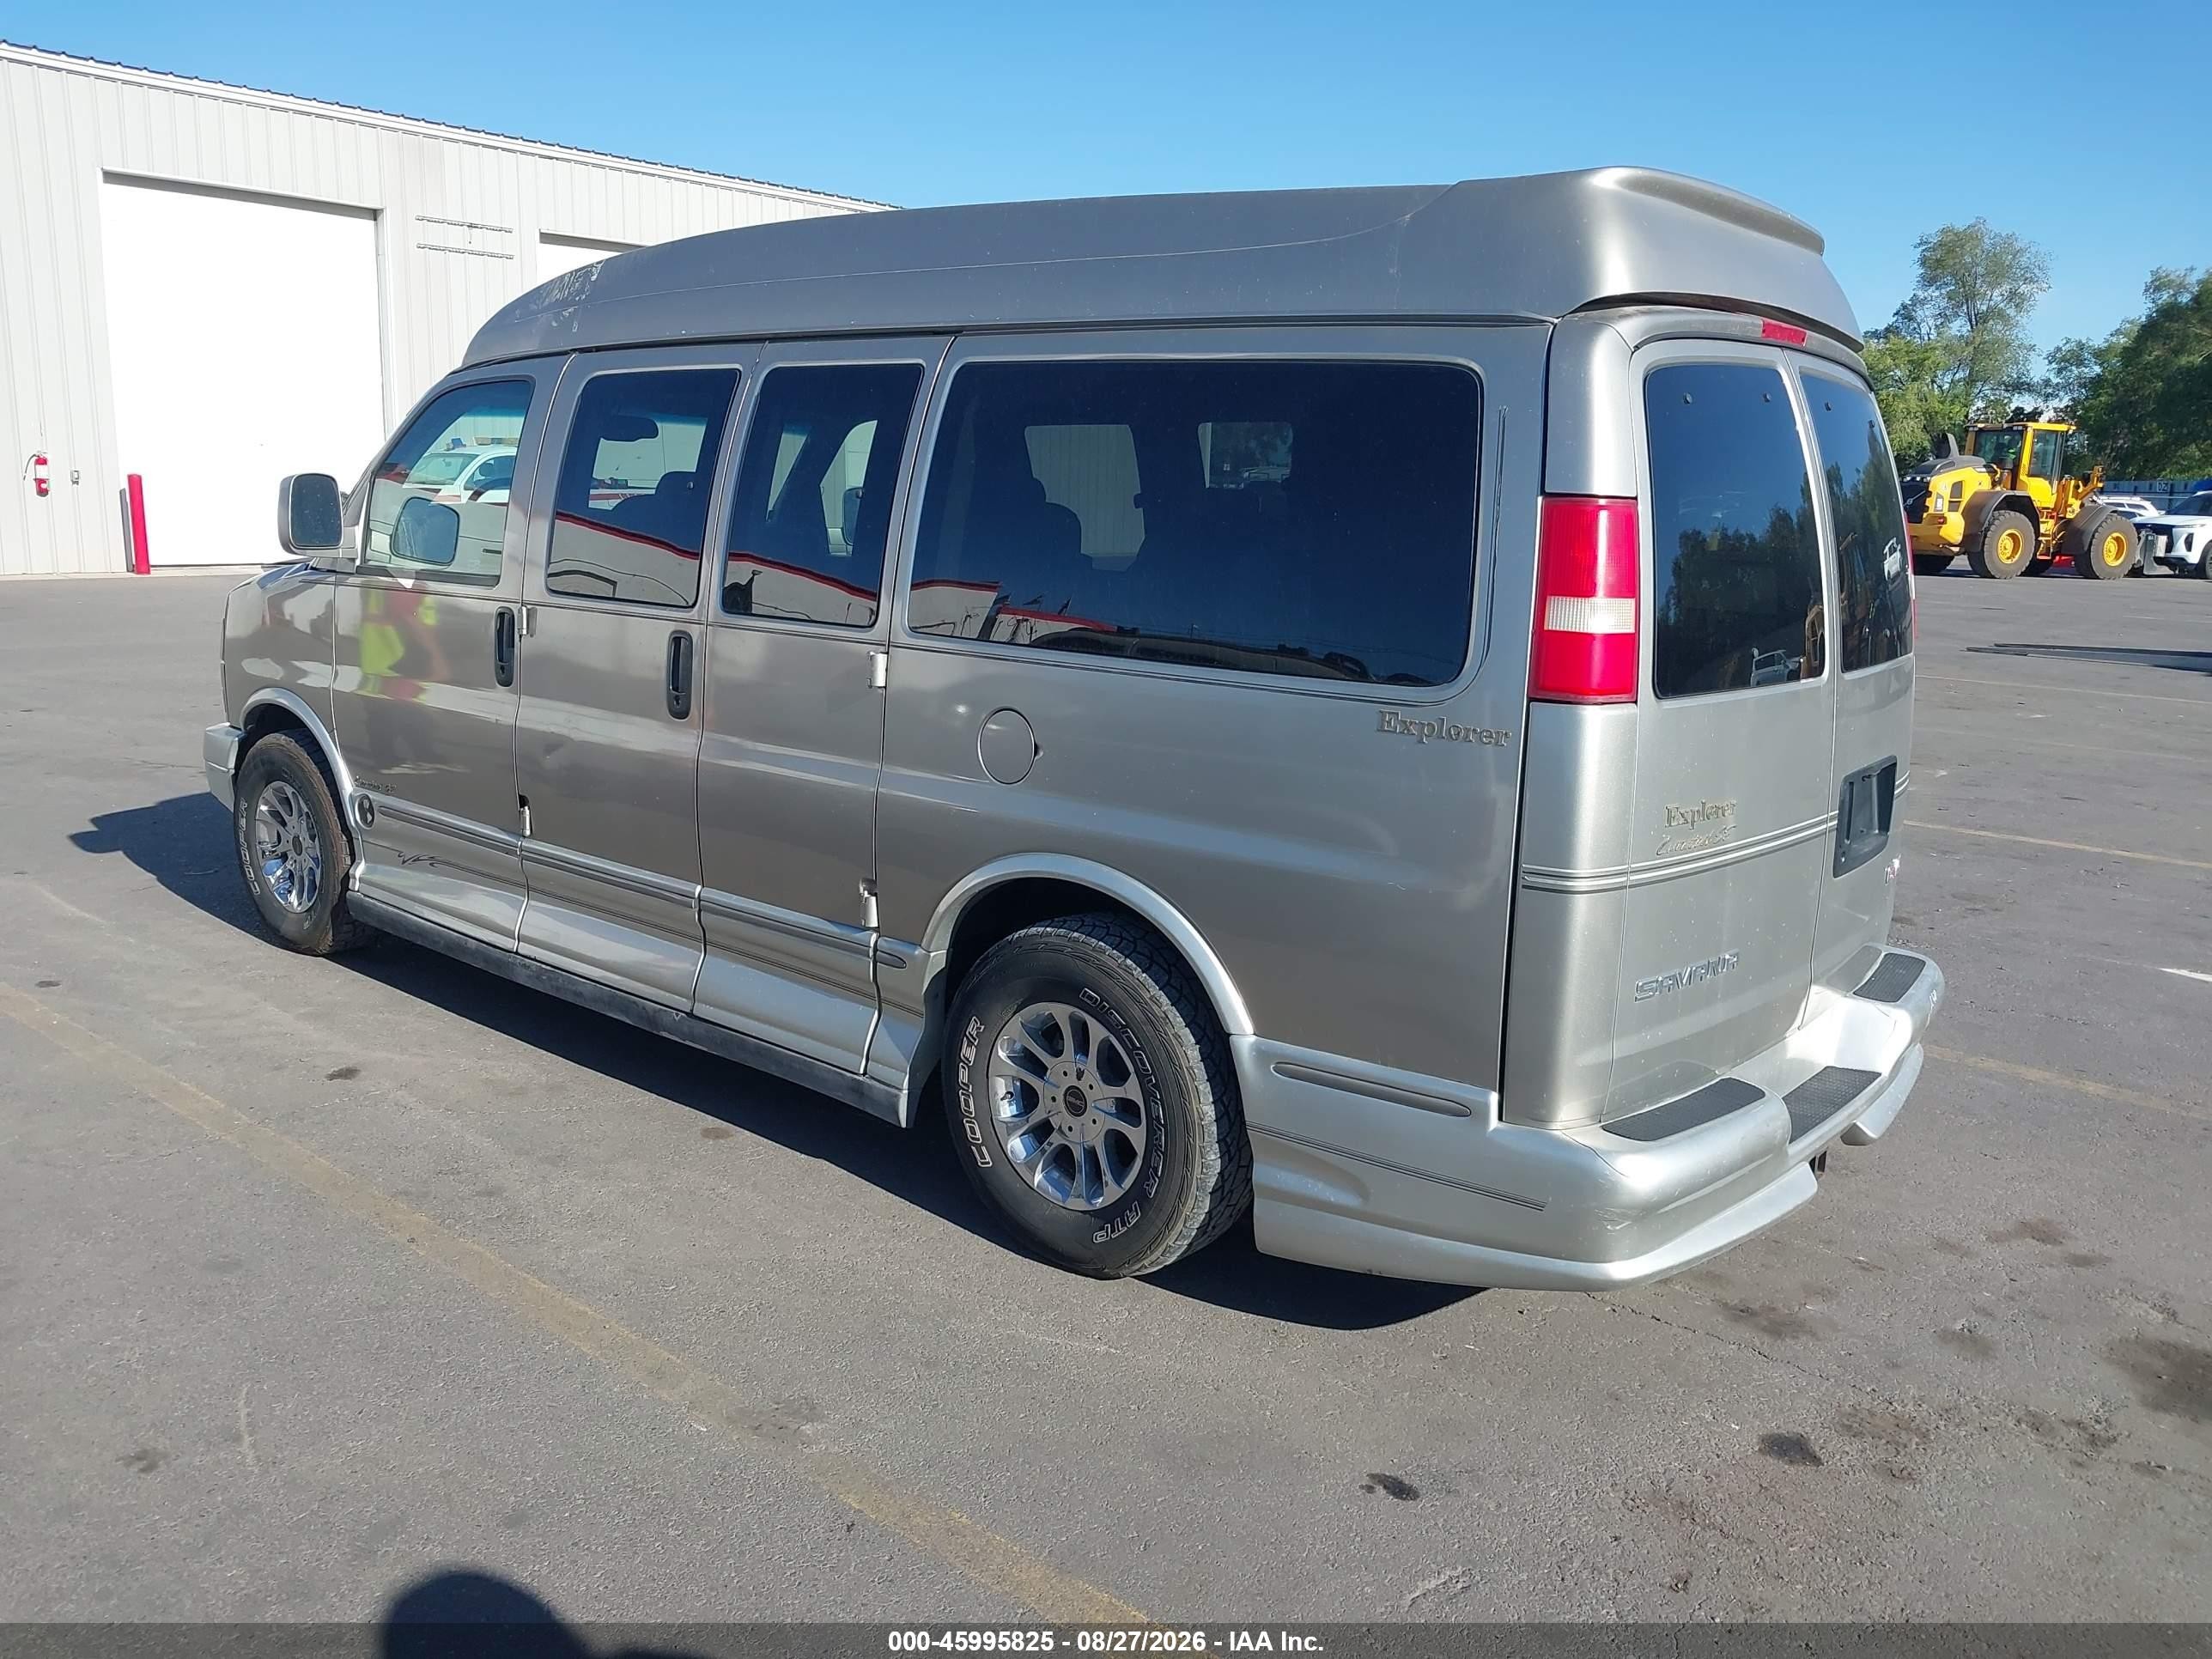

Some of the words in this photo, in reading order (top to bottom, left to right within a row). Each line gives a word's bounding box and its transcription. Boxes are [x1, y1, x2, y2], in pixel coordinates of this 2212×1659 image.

[1376, 709, 1512, 747] Explorer
[1665, 799, 1736, 831] Explorer
[239, 798, 261, 895] COOPER
[1634, 949, 1739, 1003] SAVANA
[958, 1016, 993, 1168] COOPER
[1079, 988, 1164, 1199] DISCOVERER
[1092, 1201, 1141, 1244] ATP
